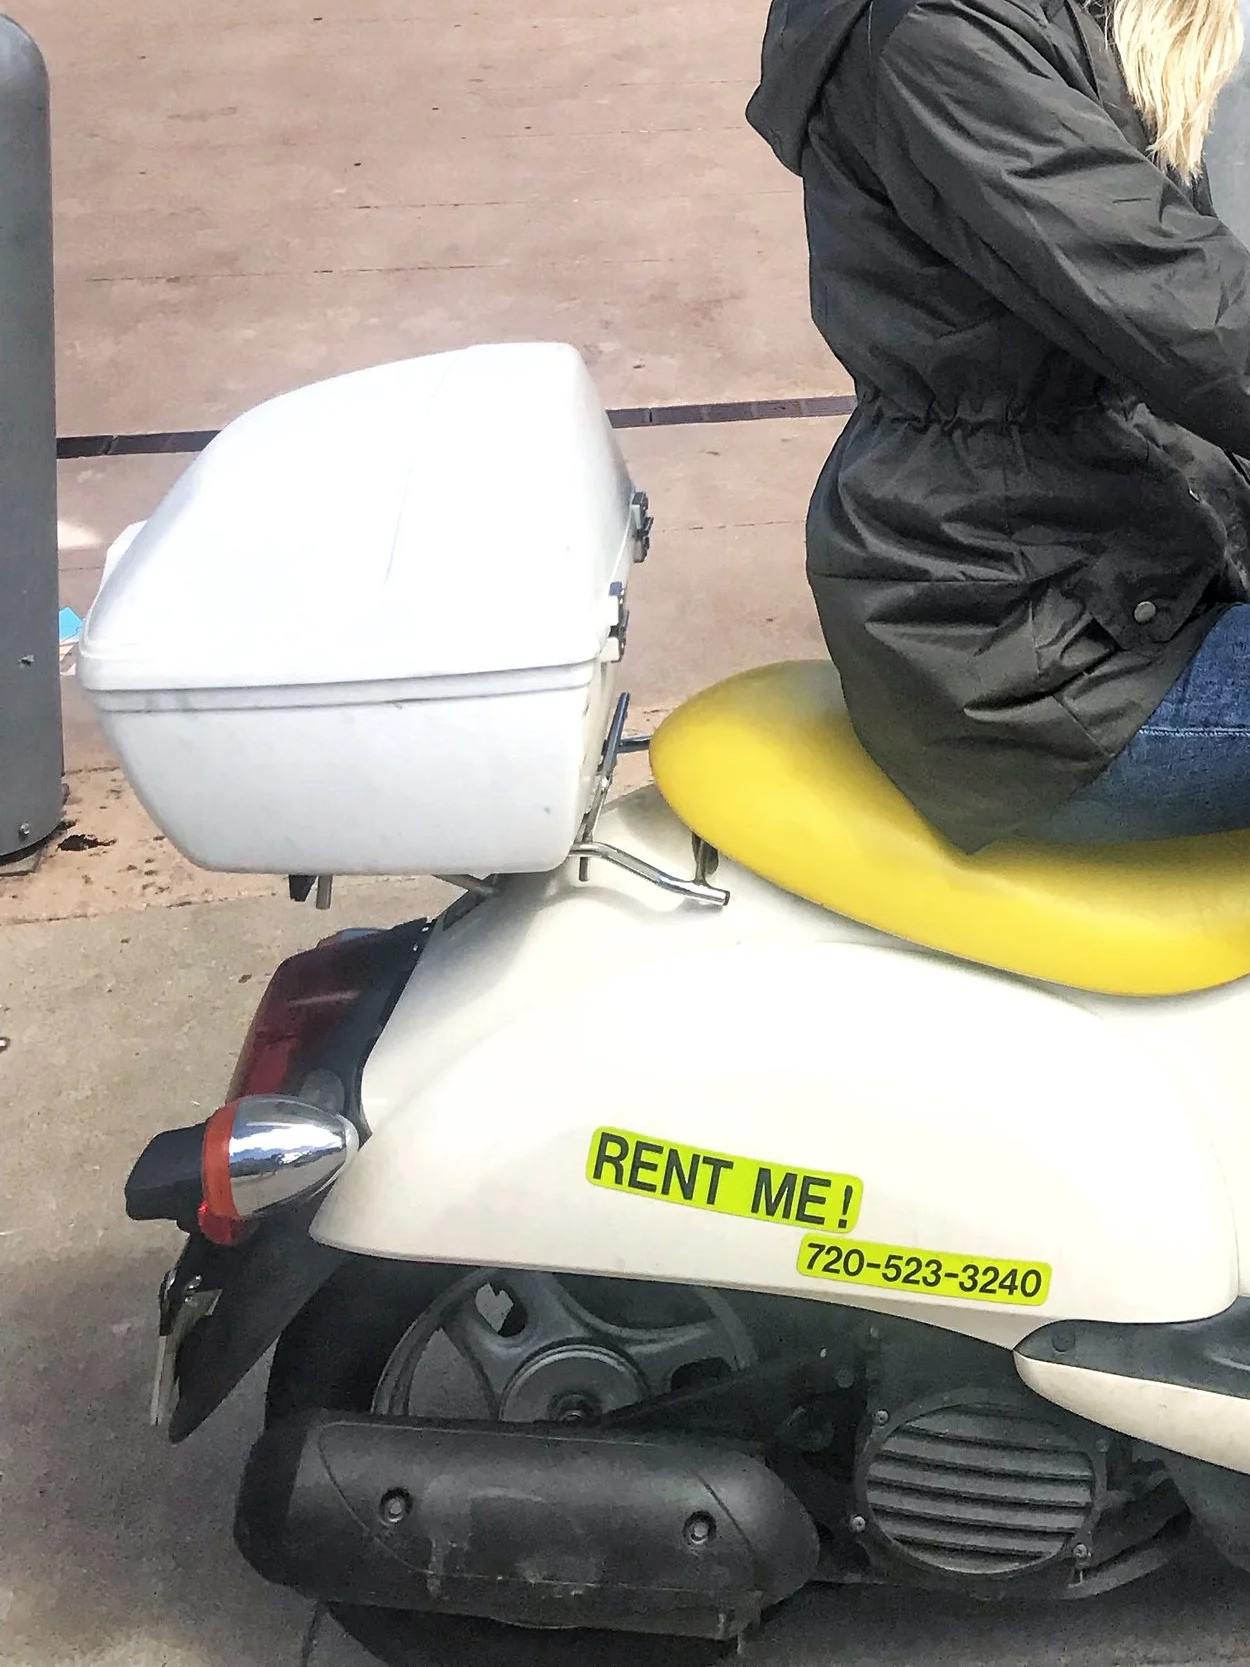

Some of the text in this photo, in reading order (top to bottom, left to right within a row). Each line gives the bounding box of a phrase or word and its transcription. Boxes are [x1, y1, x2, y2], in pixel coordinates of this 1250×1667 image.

[593, 1131, 854, 1229] RENT ME!
[807, 1242, 1042, 1298] 720-523-3240
